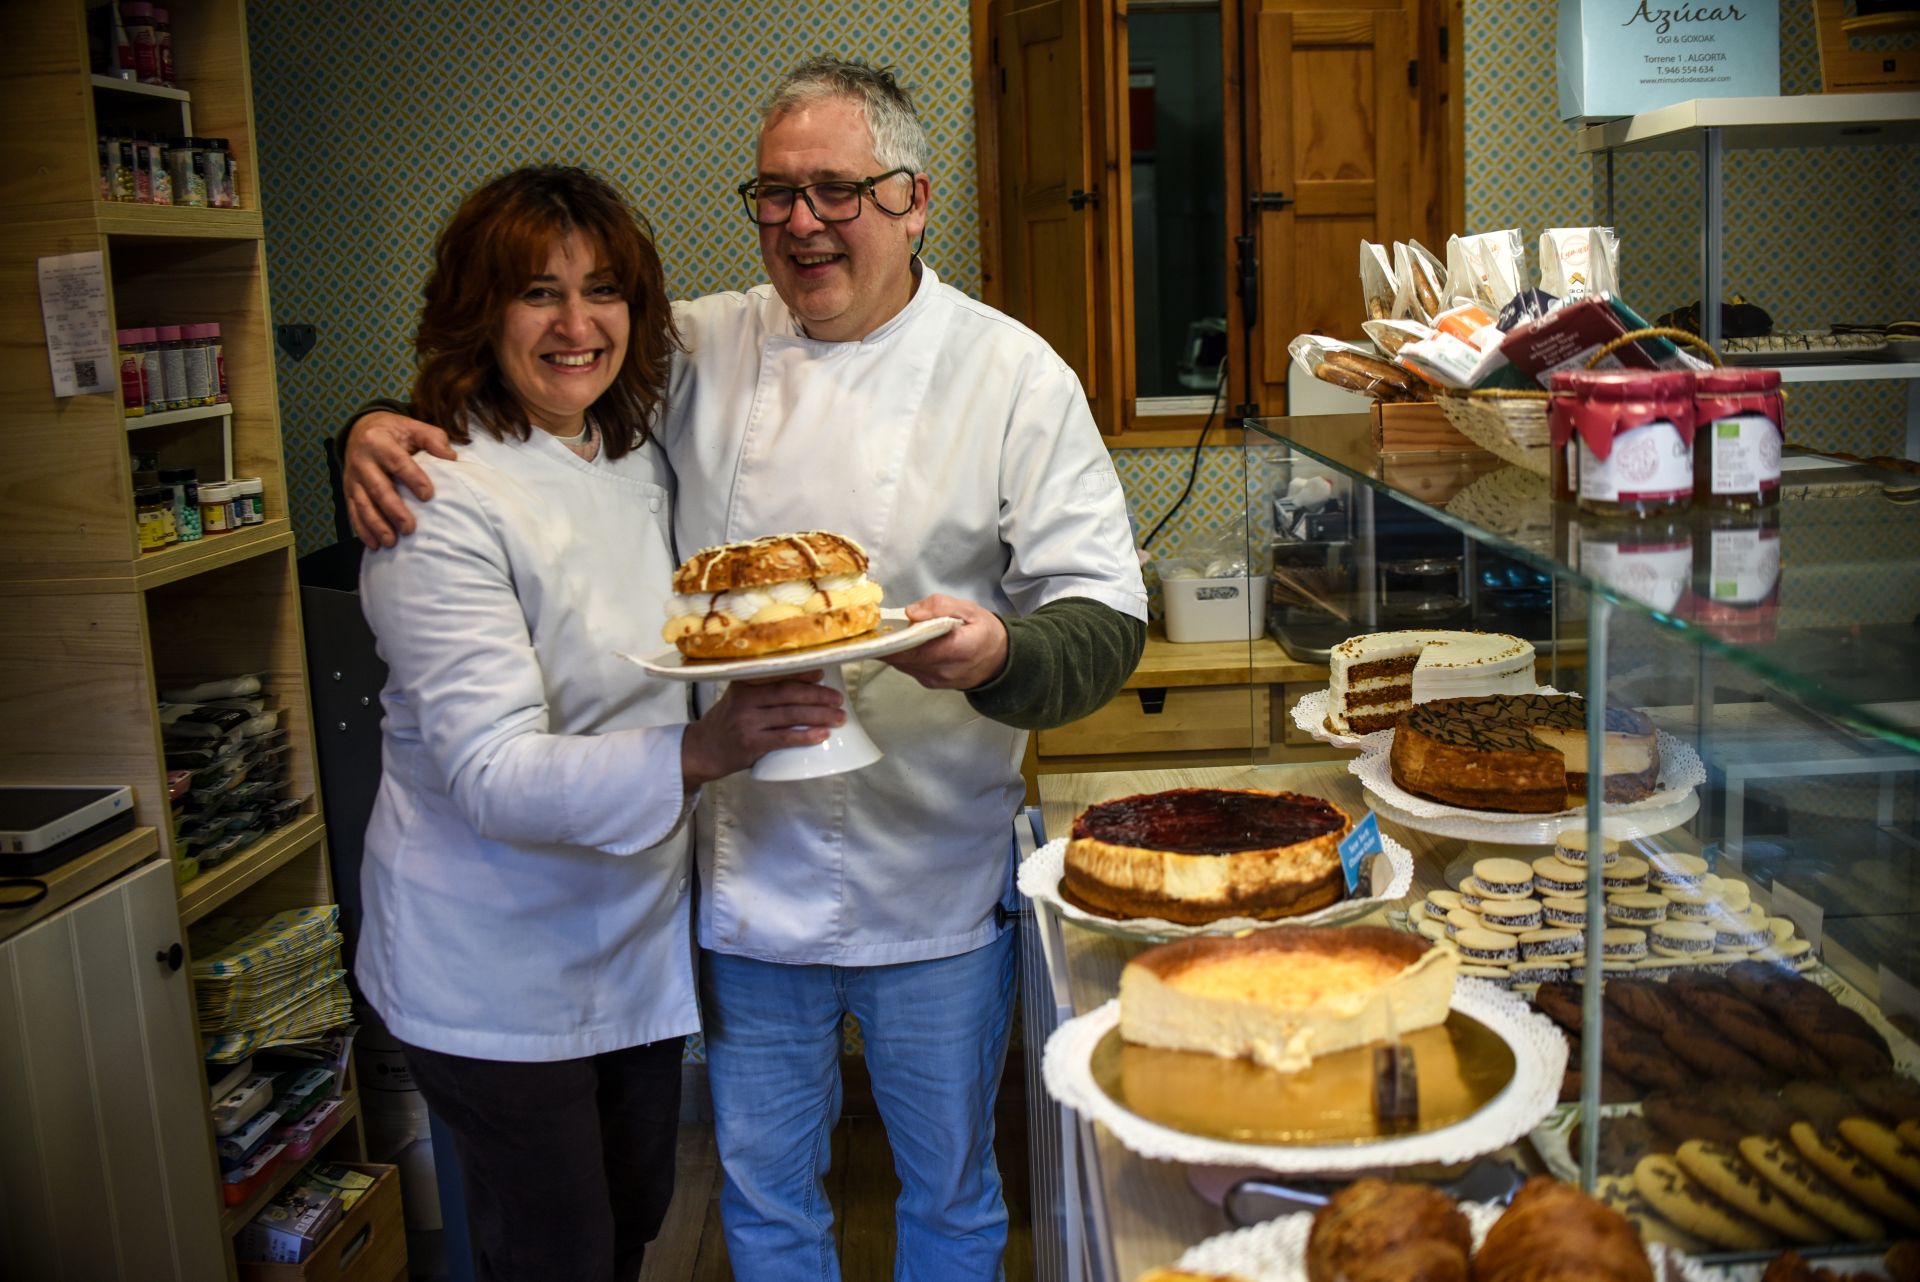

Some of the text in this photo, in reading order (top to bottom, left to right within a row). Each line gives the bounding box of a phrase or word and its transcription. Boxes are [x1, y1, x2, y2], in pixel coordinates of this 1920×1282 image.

[1621, 0, 1746, 34] Azúcar
[1656, 34, 1715, 44] OGI & GOXOAK
[1644, 55, 1675, 63] Torrene
[1688, 53, 1727, 62] ALGORTA
[1682, 65, 1697, 74] 554
[1699, 65, 1714, 74] 634
